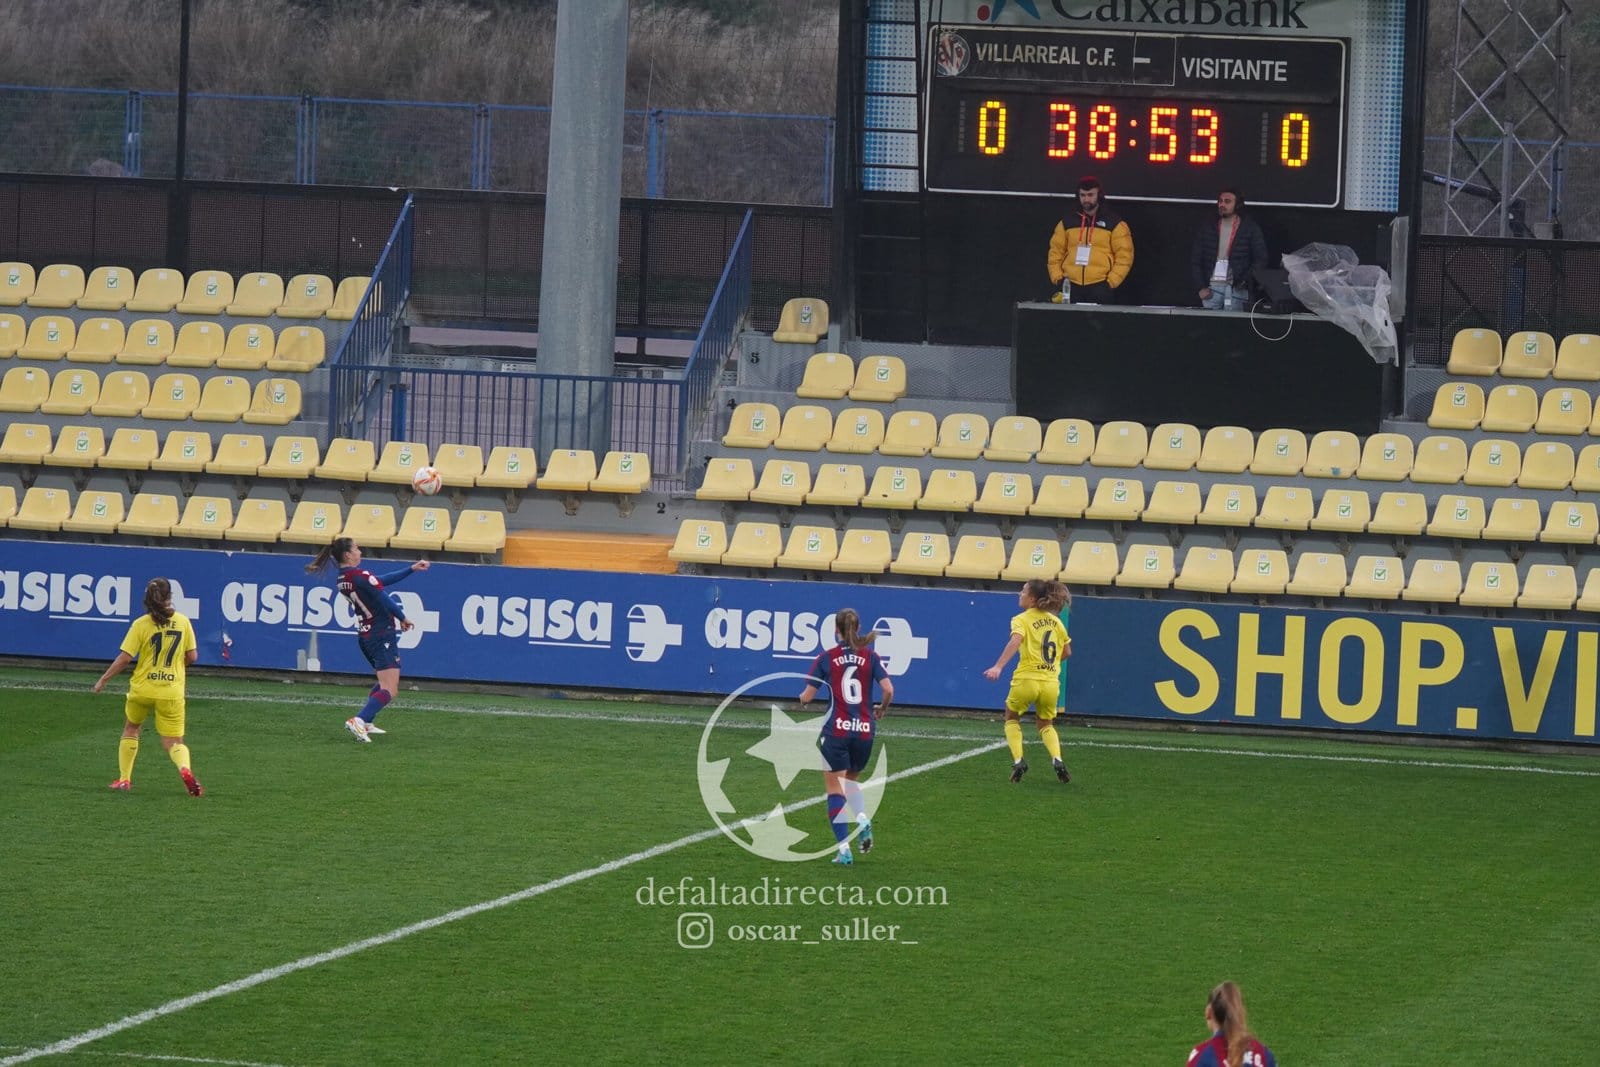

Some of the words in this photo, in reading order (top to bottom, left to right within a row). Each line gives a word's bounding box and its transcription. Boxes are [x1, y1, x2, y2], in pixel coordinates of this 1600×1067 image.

[976, 43, 1080, 65] VILLARREAL
[1086, 47, 1116, 67] C.F.
[1182, 57, 1288, 82] VISITANTE
[978, 101, 1006, 154] 0
[1048, 103, 1218, 163] 38:53
[1282, 112, 1309, 167] 0
[751, 351, 760, 364] 5
[656, 502, 666, 514] 2
[461, 595, 613, 642] asisa
[150, 630, 182, 668] 17
[833, 654, 866, 667] TOLETTI
[1042, 630, 1057, 664] 6
[841, 665, 863, 705] 6
[1154, 608, 1599, 737] SHOP.VI
[836, 717, 870, 732] teika
